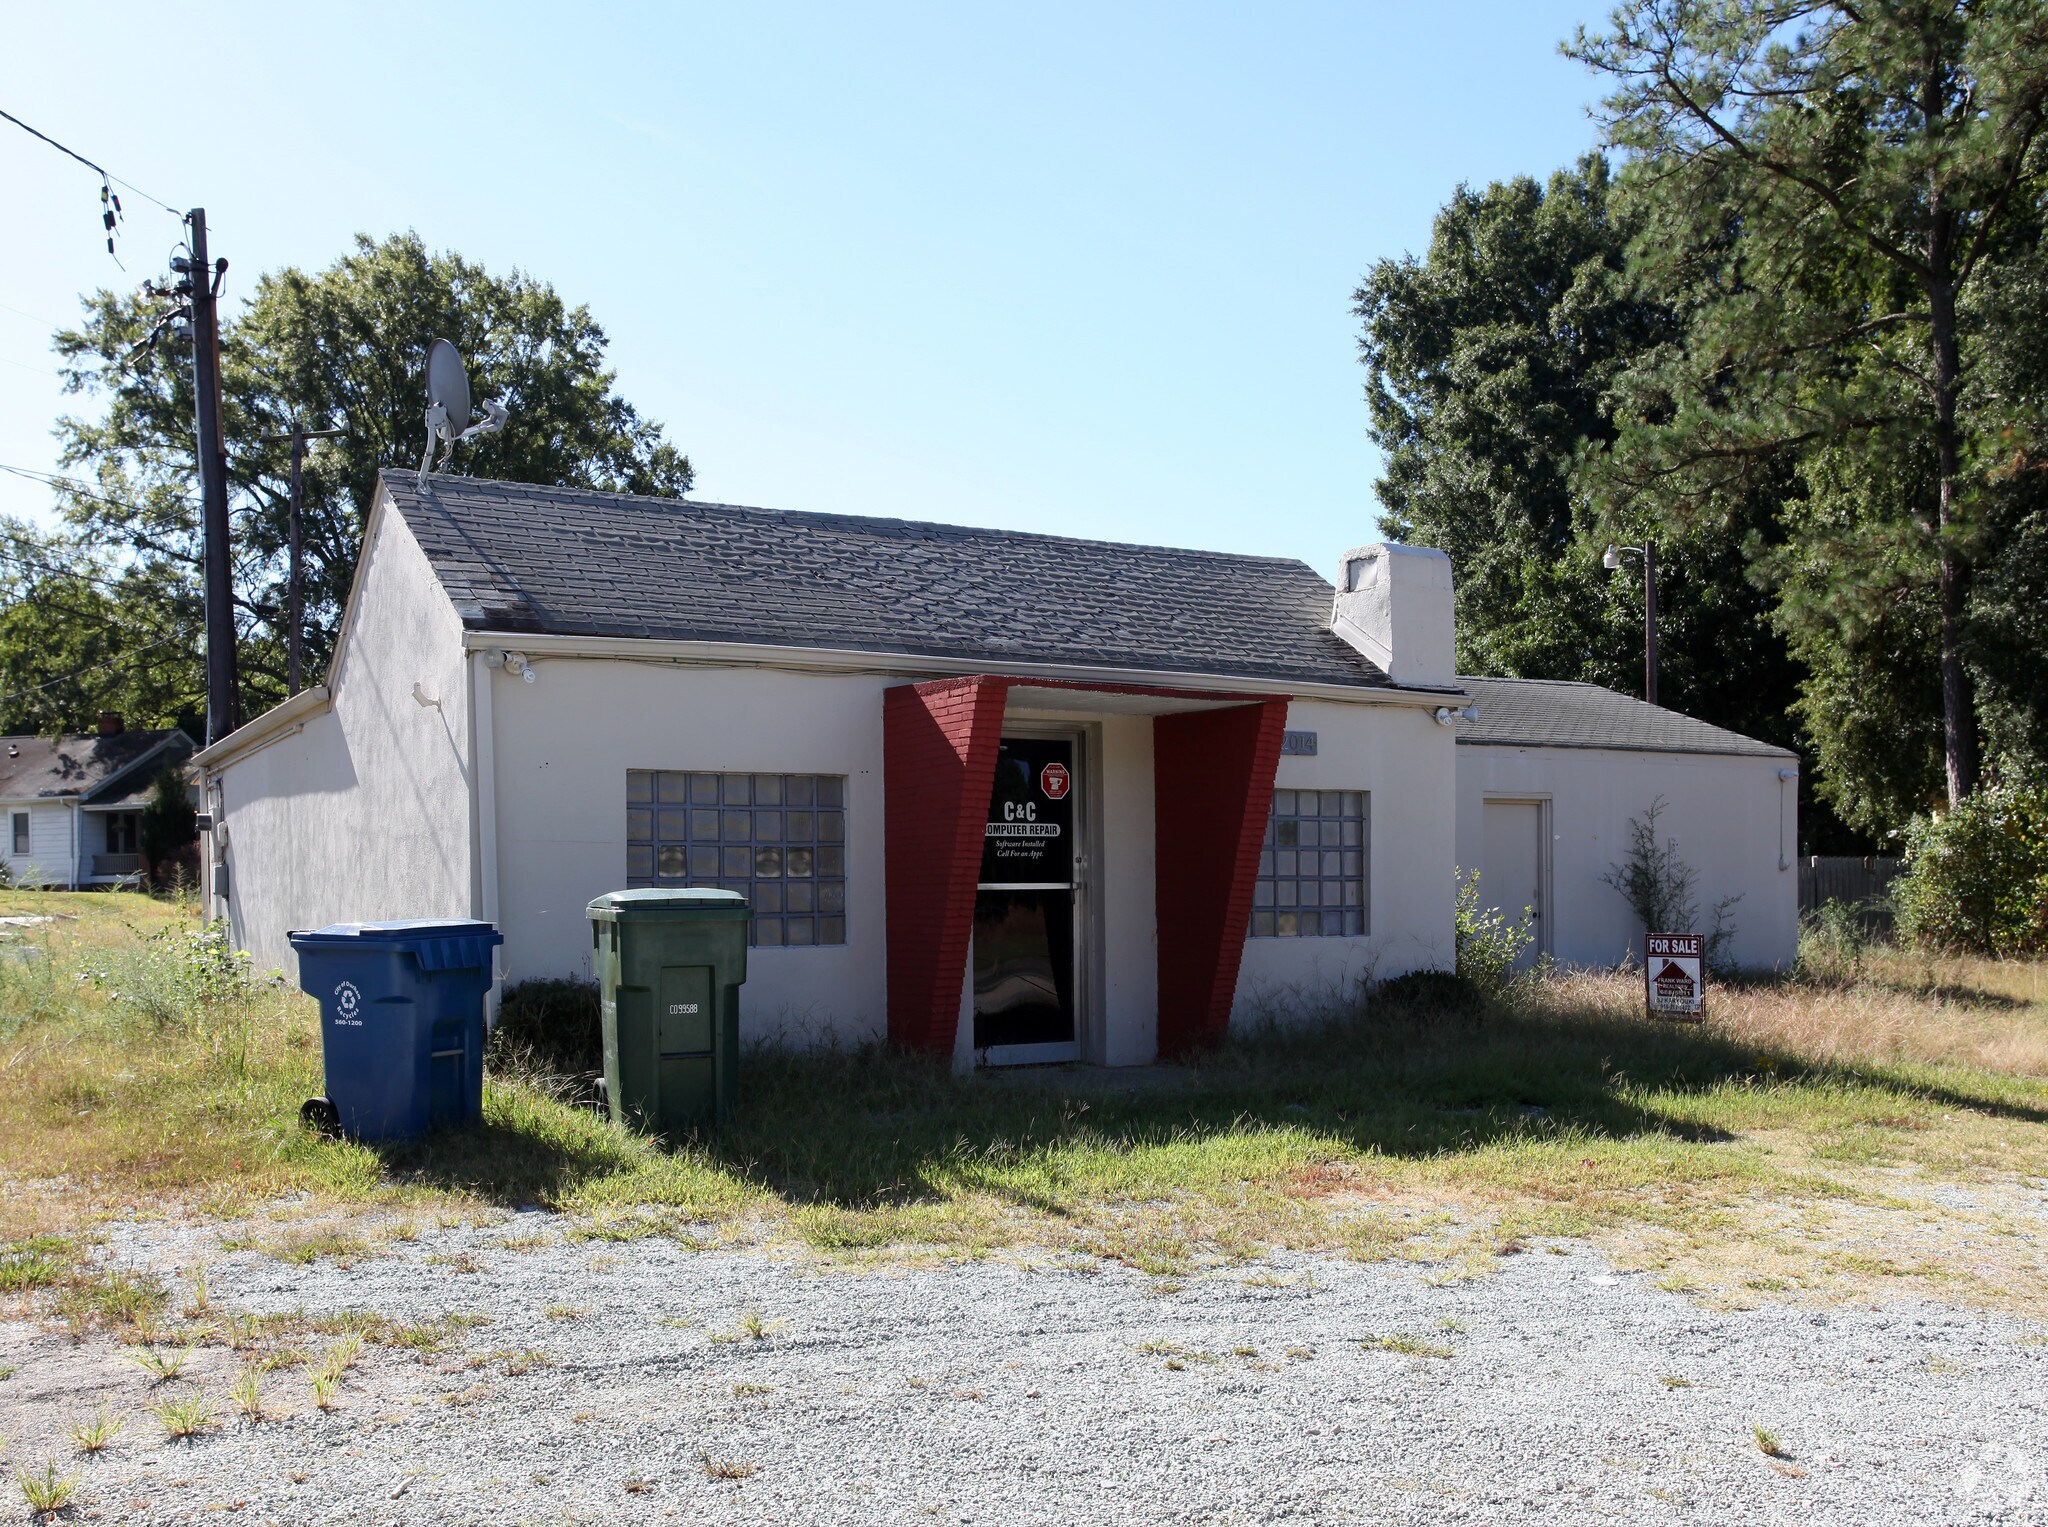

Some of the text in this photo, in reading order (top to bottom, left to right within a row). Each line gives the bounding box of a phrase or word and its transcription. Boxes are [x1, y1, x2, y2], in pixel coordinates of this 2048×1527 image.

[1004, 801, 1036, 821] C&C
[987, 824, 1058, 835] OMPUTER REPAIR
[995, 840, 1021, 849] Software
[1028, 850, 1044, 859] Appt.
[1649, 939, 1697, 954] FOR SALE
